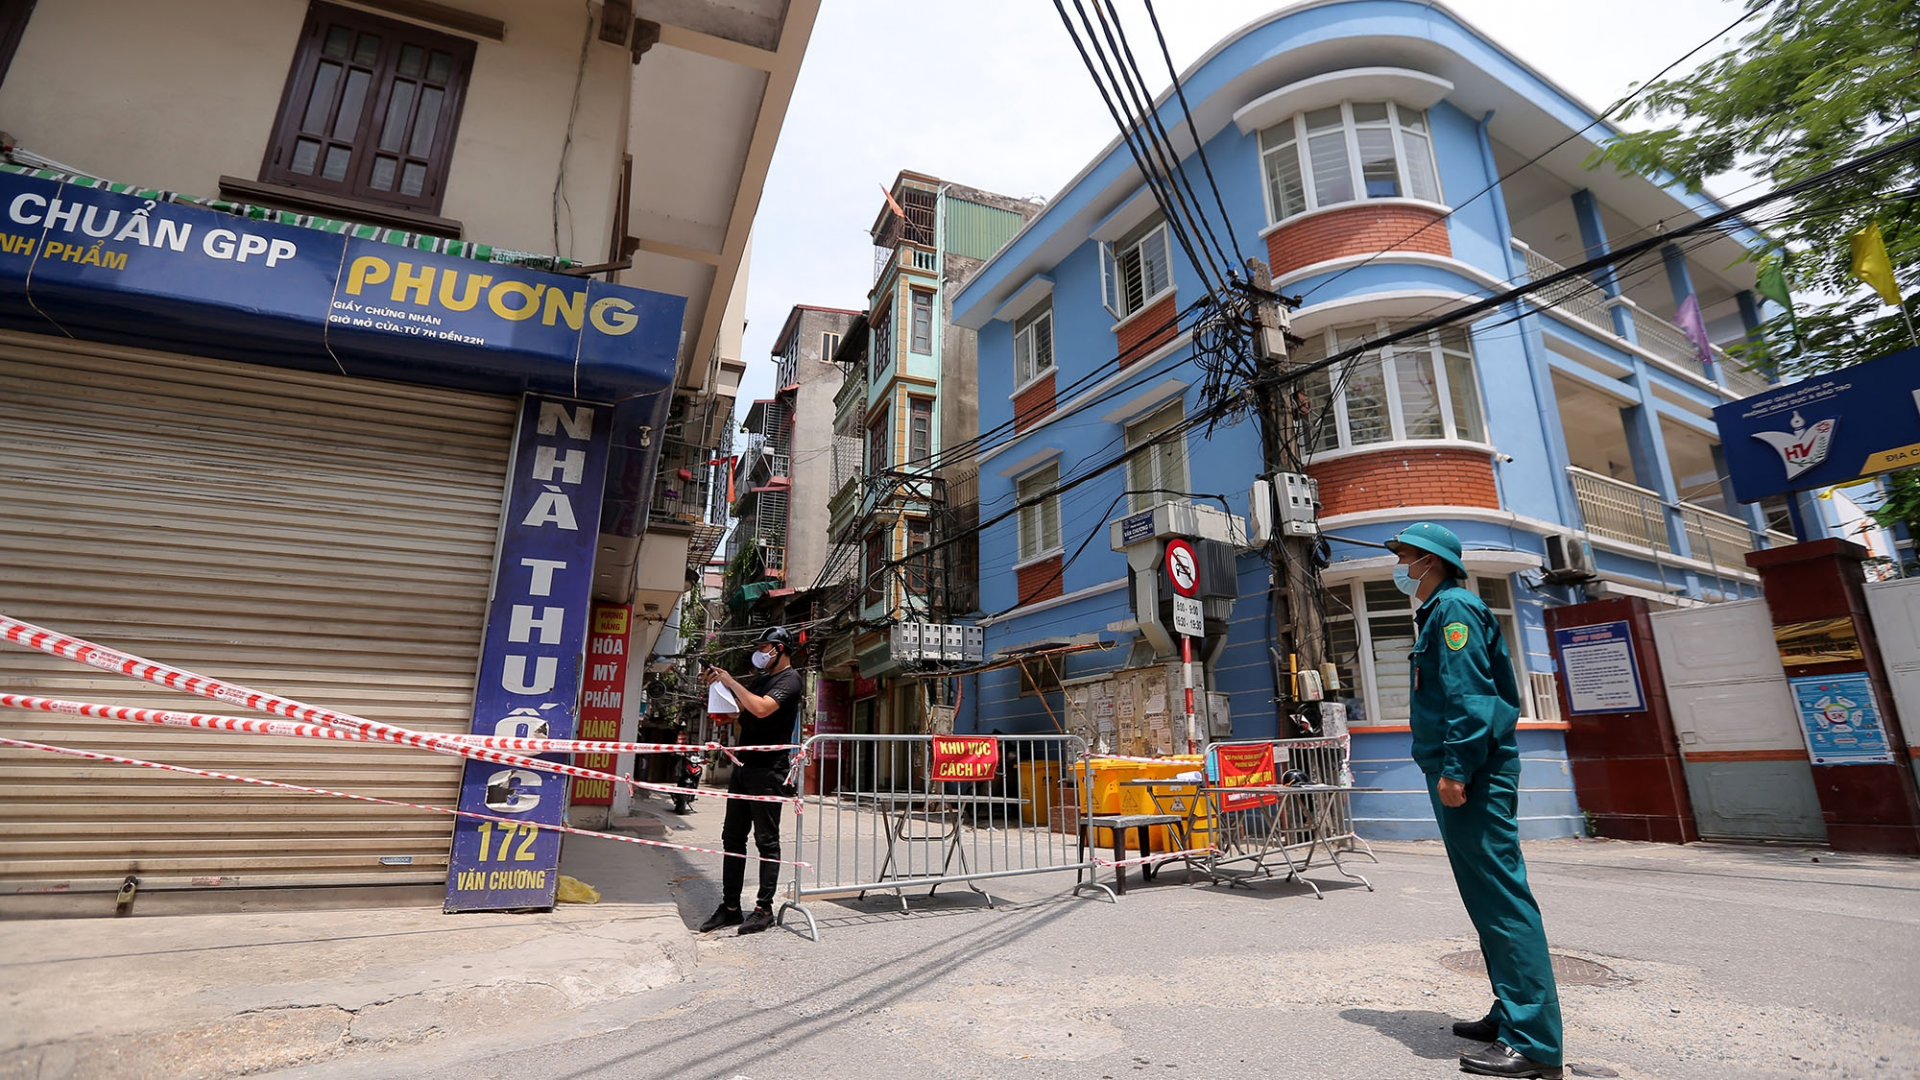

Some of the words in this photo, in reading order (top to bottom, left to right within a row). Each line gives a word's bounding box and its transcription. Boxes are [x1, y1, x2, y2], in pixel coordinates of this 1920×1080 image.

[9, 193, 193, 253] CHUẨN
[202, 228, 298, 268] GPP
[43, 240, 129, 271] PHẨM
[345, 255, 640, 337] PHƯƠNG
[333, 300, 363, 312] GIẤY
[365, 306, 406, 320] CHỨNG
[408, 312, 442, 327] NHẬN
[329, 314, 351, 325] GIỜ
[352, 317, 373, 328] MỞ
[422, 328, 437, 338] 7H
[463, 335, 485, 346] 22H
[521, 401, 597, 532] NHÀ
[1885, 452, 1908, 463] ĐỊA
[1909, 448, 1920, 457] C
[591, 635, 624, 656] HÓA
[592, 661, 619, 682] MỸ
[583, 684, 622, 709] PHẨM
[582, 716, 617, 739] HÀNG
[939, 741, 965, 755] KHU
[967, 740, 992, 758] VỰC
[939, 760, 974, 777] CÁCH
[976, 763, 992, 777] LY
[477, 820, 539, 862] 172
[457, 867, 486, 891] VĂN
[488, 869, 546, 890] CHƯƠNG
